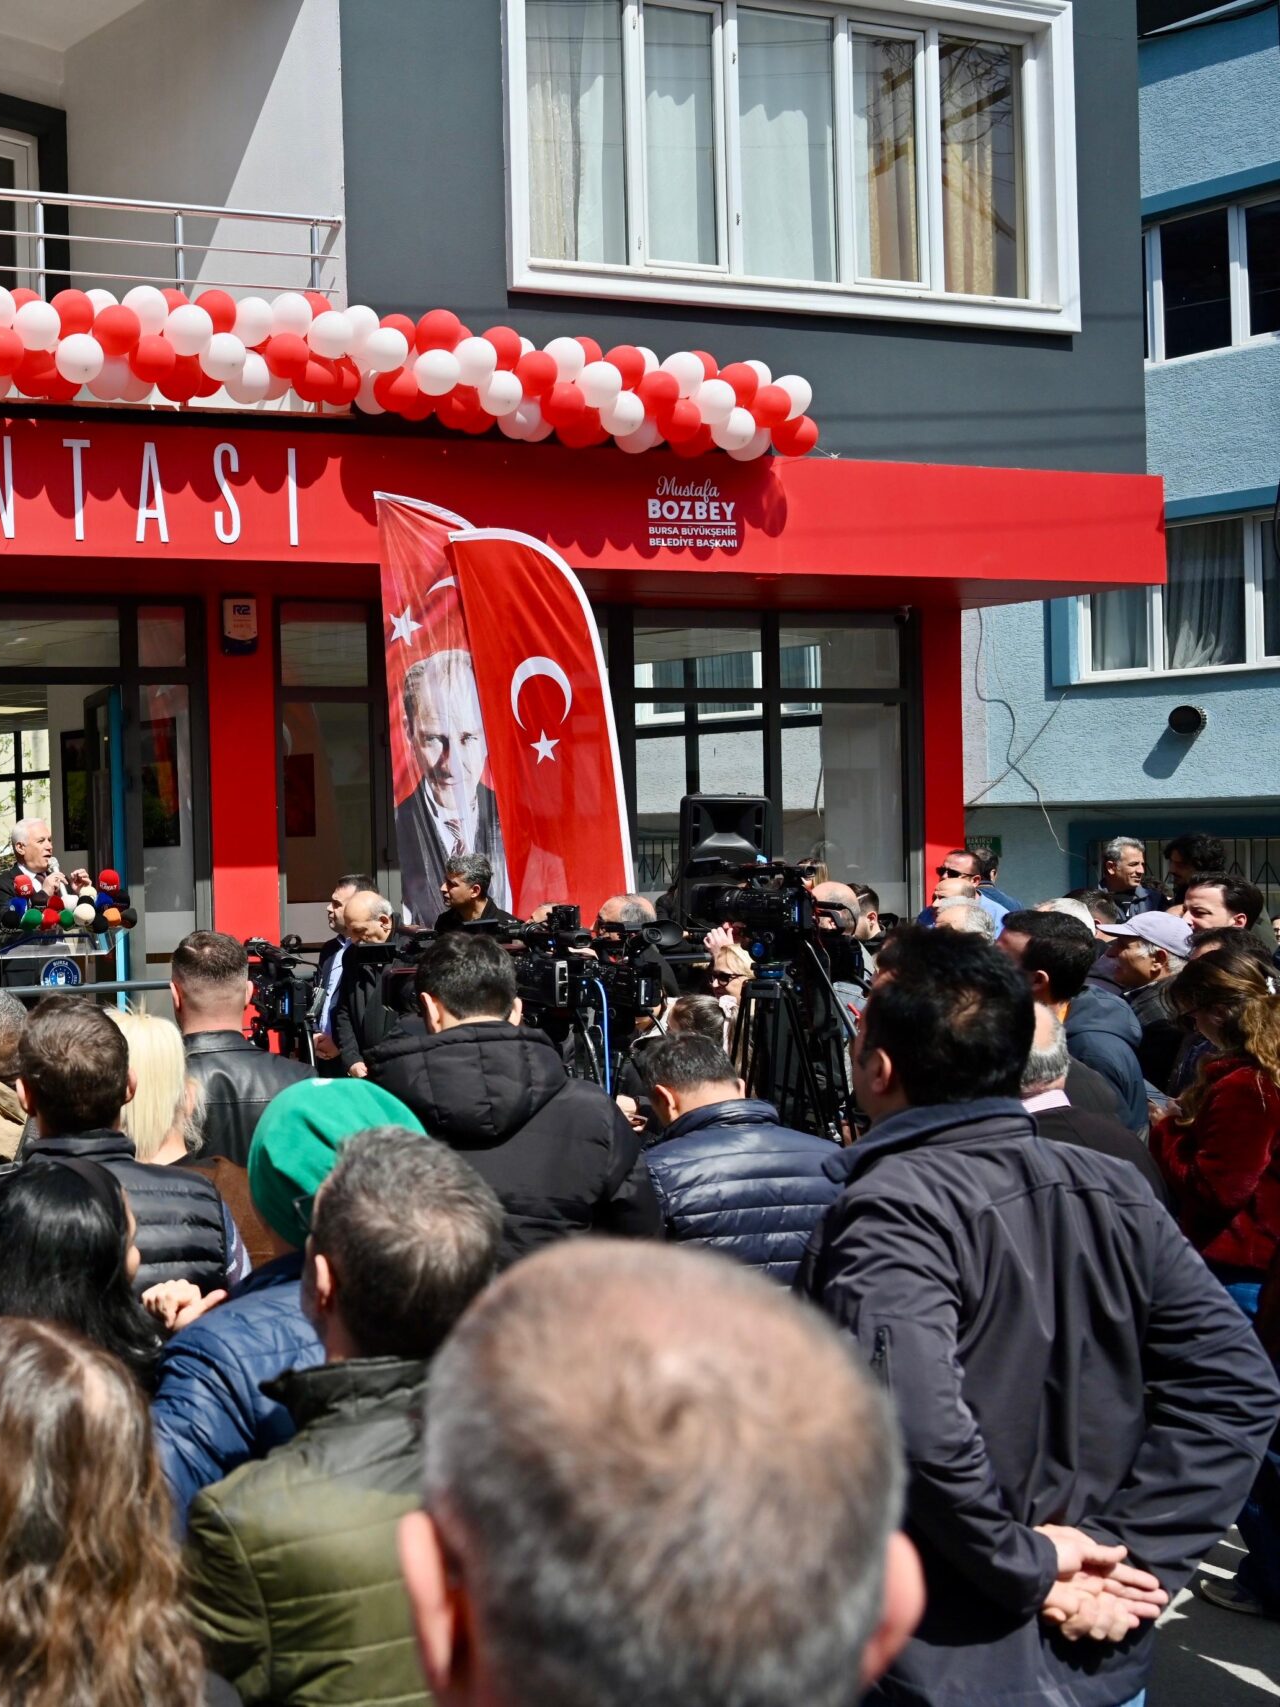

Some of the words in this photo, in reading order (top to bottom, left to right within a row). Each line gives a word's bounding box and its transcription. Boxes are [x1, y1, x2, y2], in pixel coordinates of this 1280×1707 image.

[656, 476, 720, 503] Mustafa
[647, 499, 735, 520] BOZBEY
[648, 526, 679, 535] BURSA
[681, 525, 737, 537] BÜYÜKŞEHİR
[649, 536, 694, 547] BELEDİYE
[696, 538, 738, 549] BAŞKANI
[233, 604, 251, 615] R2
